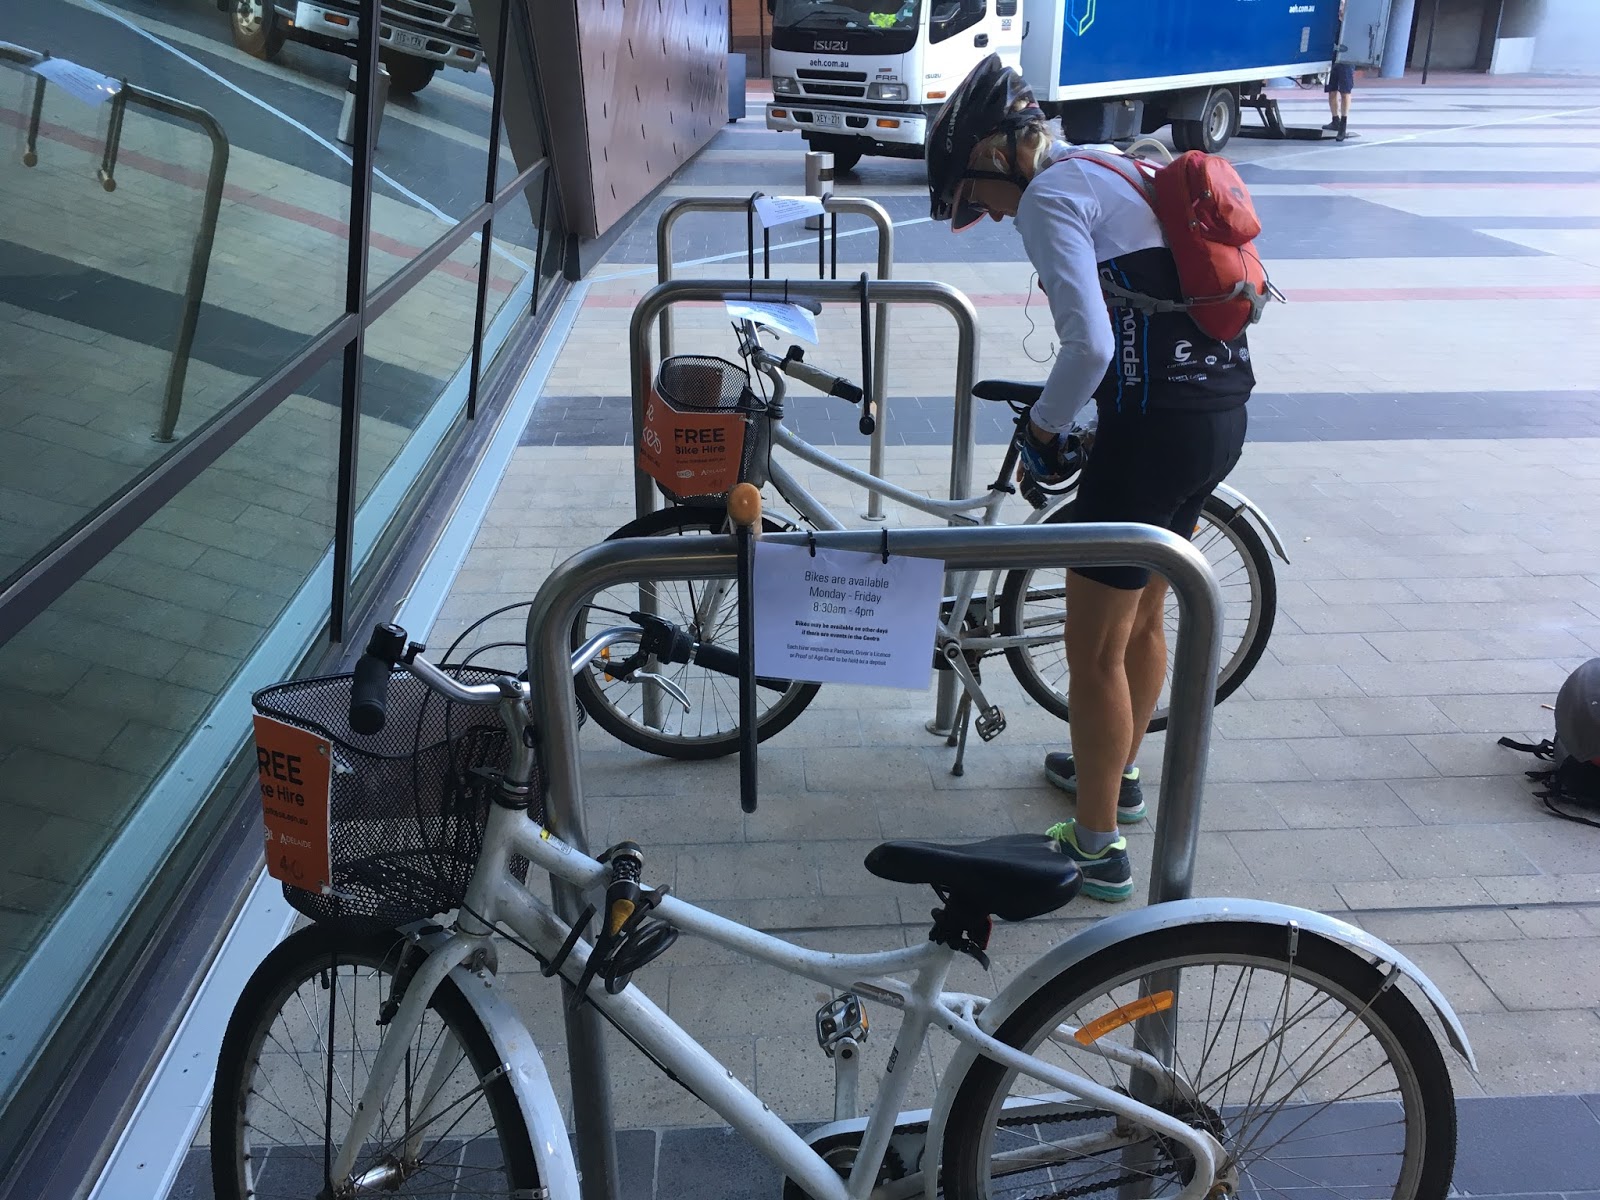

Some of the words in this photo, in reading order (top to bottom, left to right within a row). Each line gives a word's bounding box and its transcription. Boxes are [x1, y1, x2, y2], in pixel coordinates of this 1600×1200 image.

[1288, 4, 1315, 14] aeh.com.au
[814, 40, 848, 50] ISUZU
[810, 58, 849, 68] aeh.com.au
[674, 428, 725, 444] FREE
[676, 446, 699, 454] Bike
[702, 446, 726, 454] Hire
[804, 571, 829, 583] Bikes
[832, 576, 846, 584] are
[848, 577, 889, 588] available
[810, 587, 846, 600] Monday
[854, 590, 882, 604] Friday
[813, 602, 846, 614] 8:30am
[855, 606, 874, 617] 4pm
[256, 746, 304, 785] REE
[277, 785, 304, 806] Hire
[280, 832, 312, 848] ADELAIDE
